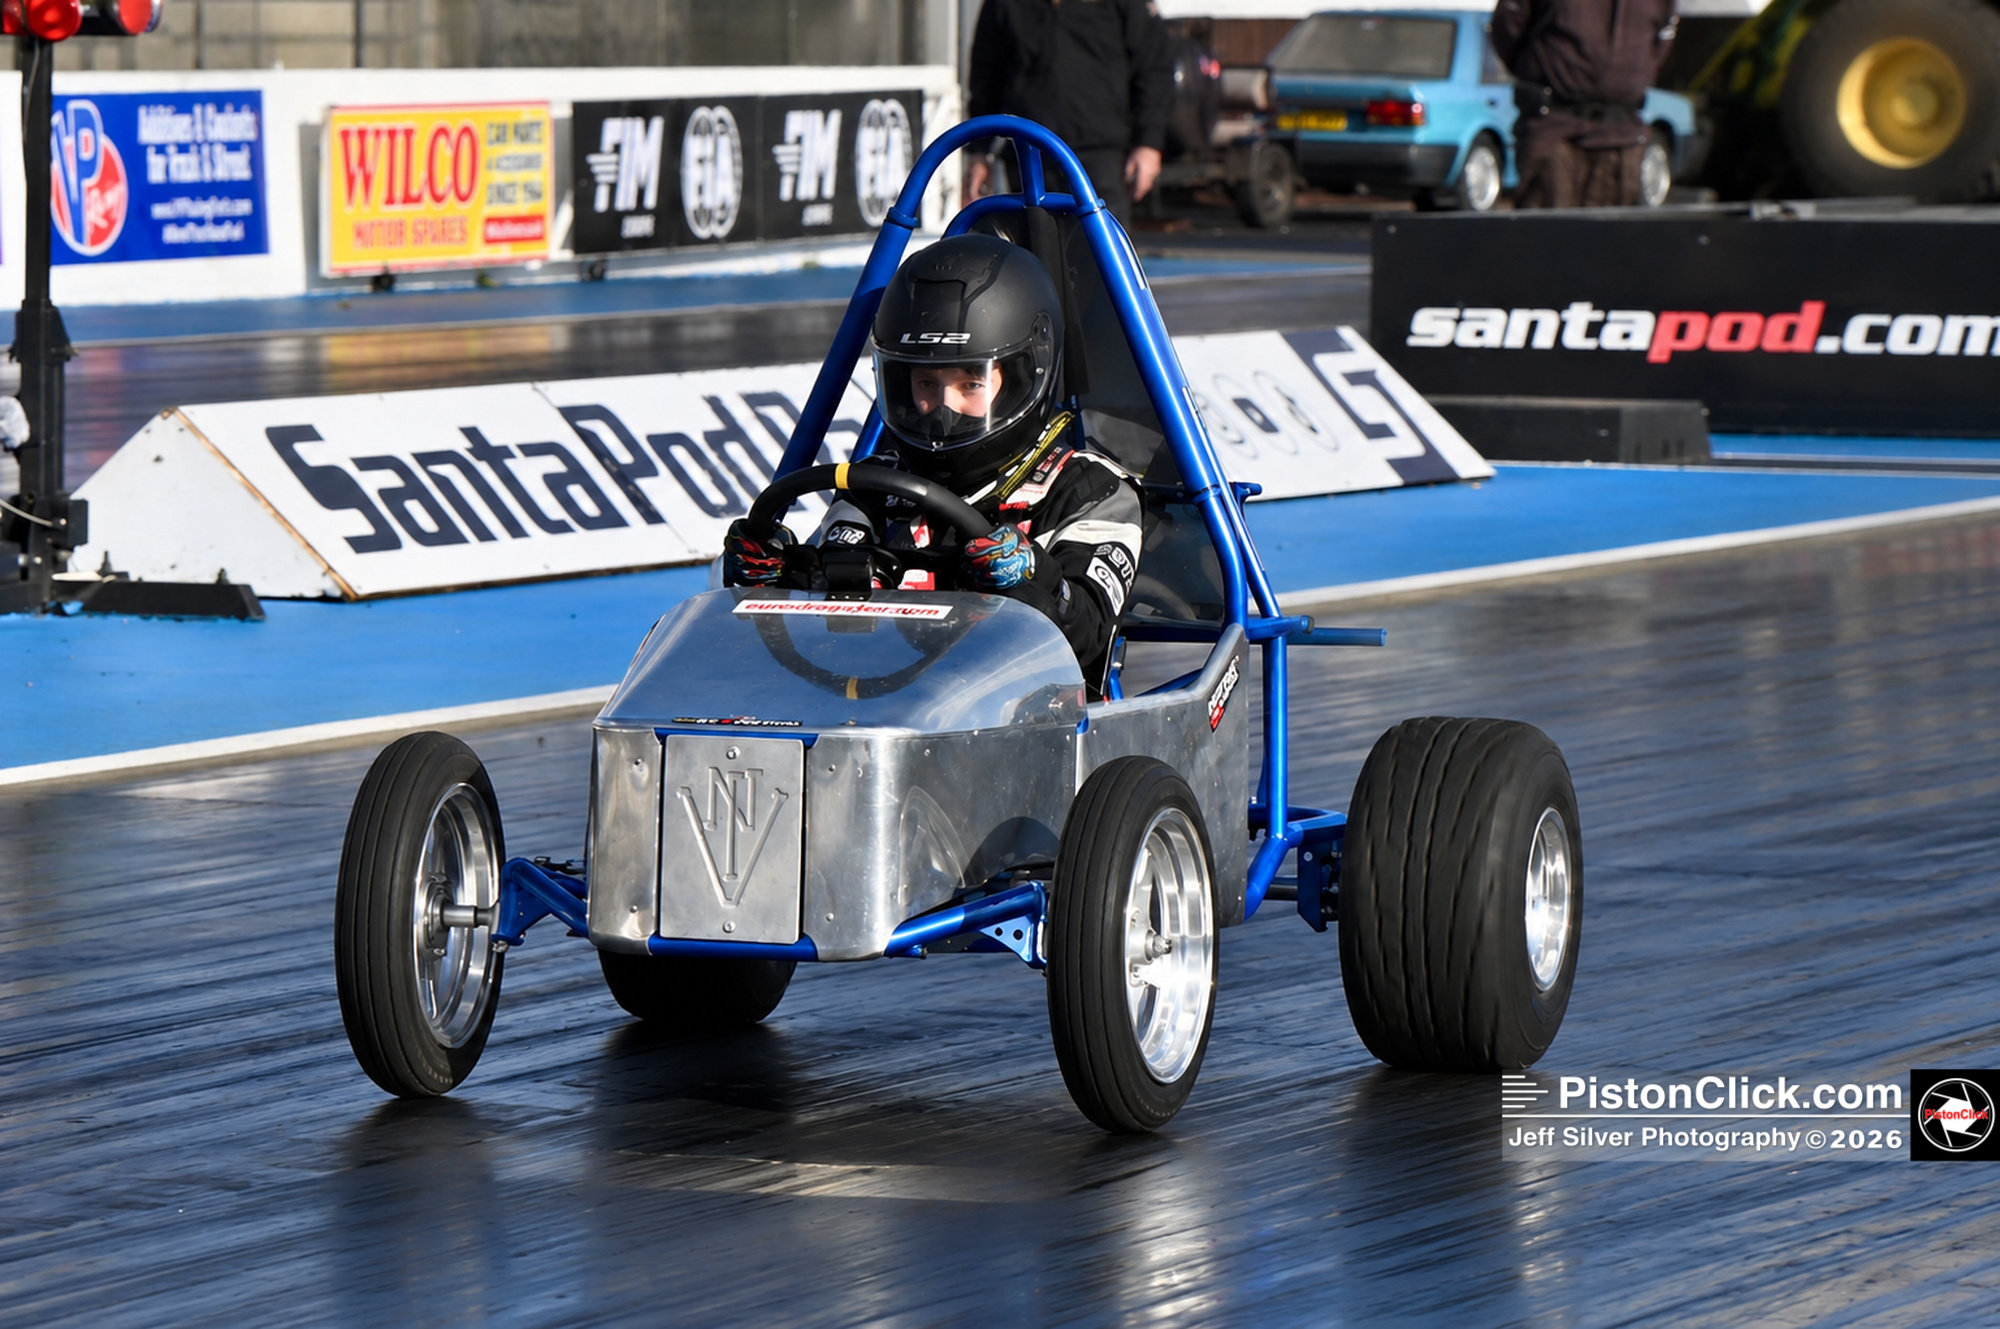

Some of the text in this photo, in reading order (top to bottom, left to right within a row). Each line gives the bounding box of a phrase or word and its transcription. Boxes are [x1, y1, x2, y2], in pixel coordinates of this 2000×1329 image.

[339, 125, 478, 209] WILCO
[900, 332, 971, 345] LS2
[1407, 301, 2000, 364] santapod.com
